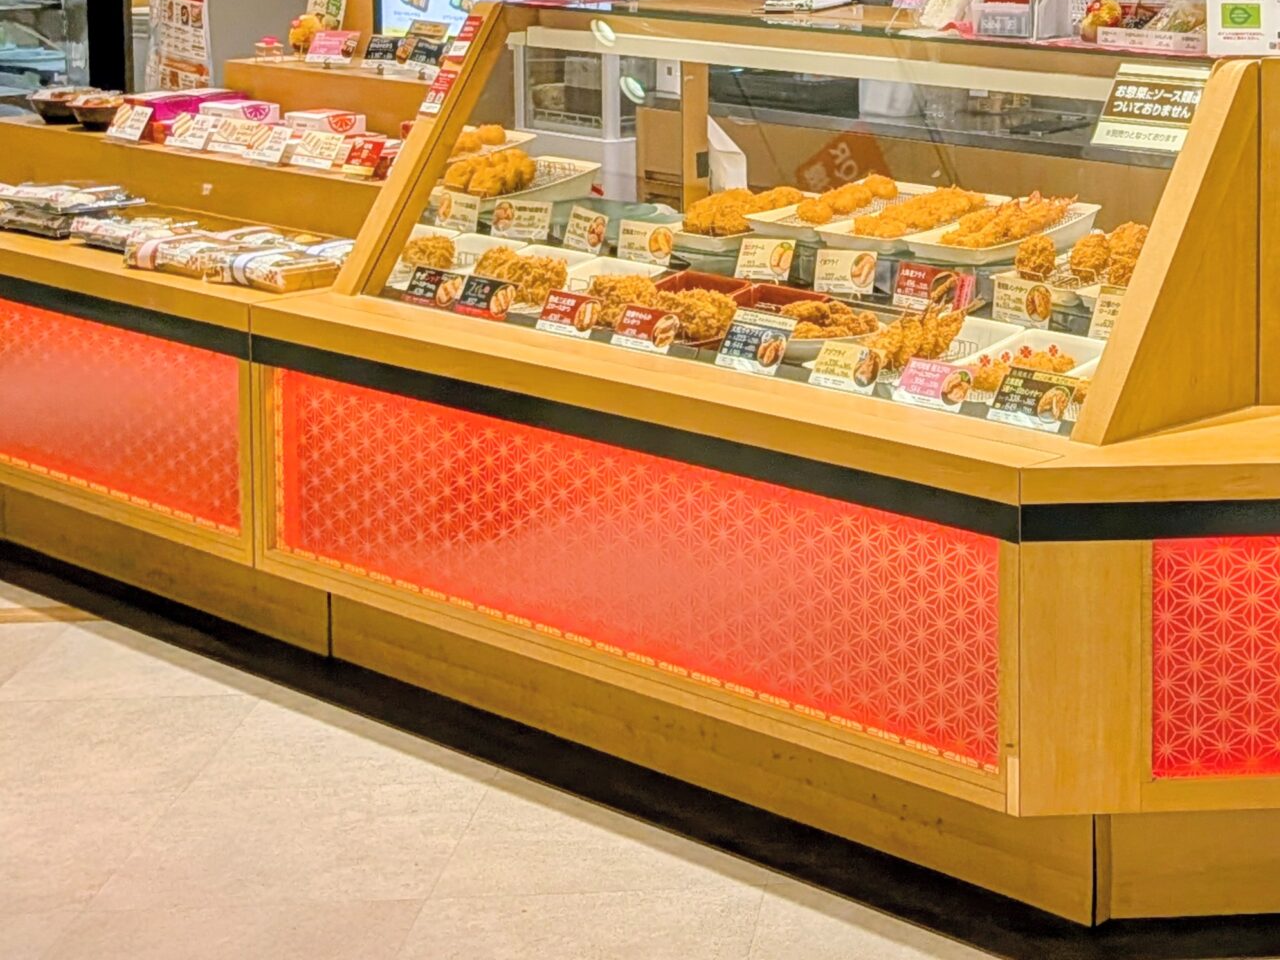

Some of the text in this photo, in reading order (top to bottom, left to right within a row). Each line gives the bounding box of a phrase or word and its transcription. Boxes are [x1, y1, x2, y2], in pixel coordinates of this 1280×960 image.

[1114, 85, 1202, 104] お惣菜にソース類は
[1112, 100, 1191, 119] ついておりません
